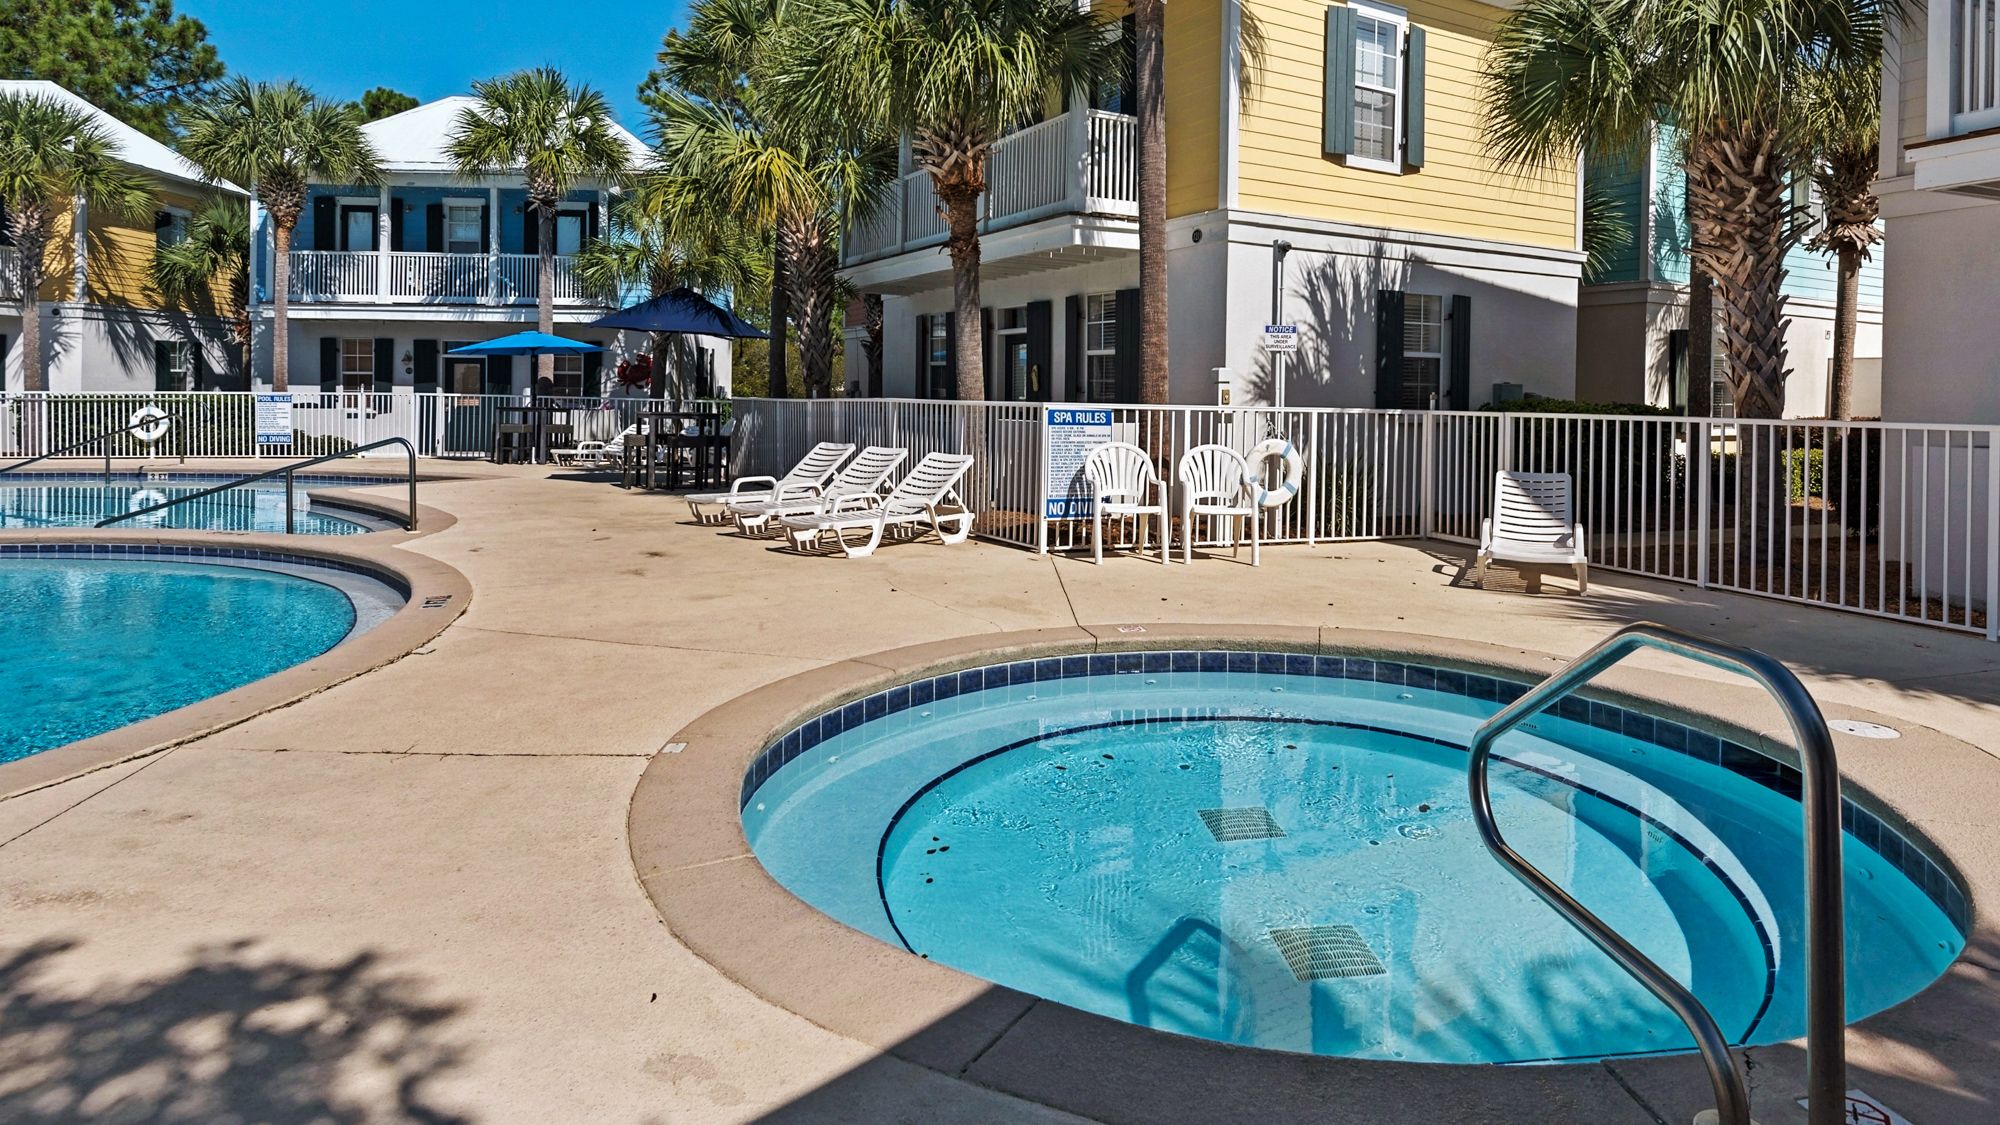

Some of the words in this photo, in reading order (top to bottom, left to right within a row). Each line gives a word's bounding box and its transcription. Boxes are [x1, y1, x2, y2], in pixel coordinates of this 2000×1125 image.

[1053, 411, 1073, 423] SPA
[1075, 411, 1107, 423] RULES
[1048, 501, 1066, 516] NO
[1069, 501, 1093, 515] DIVI
